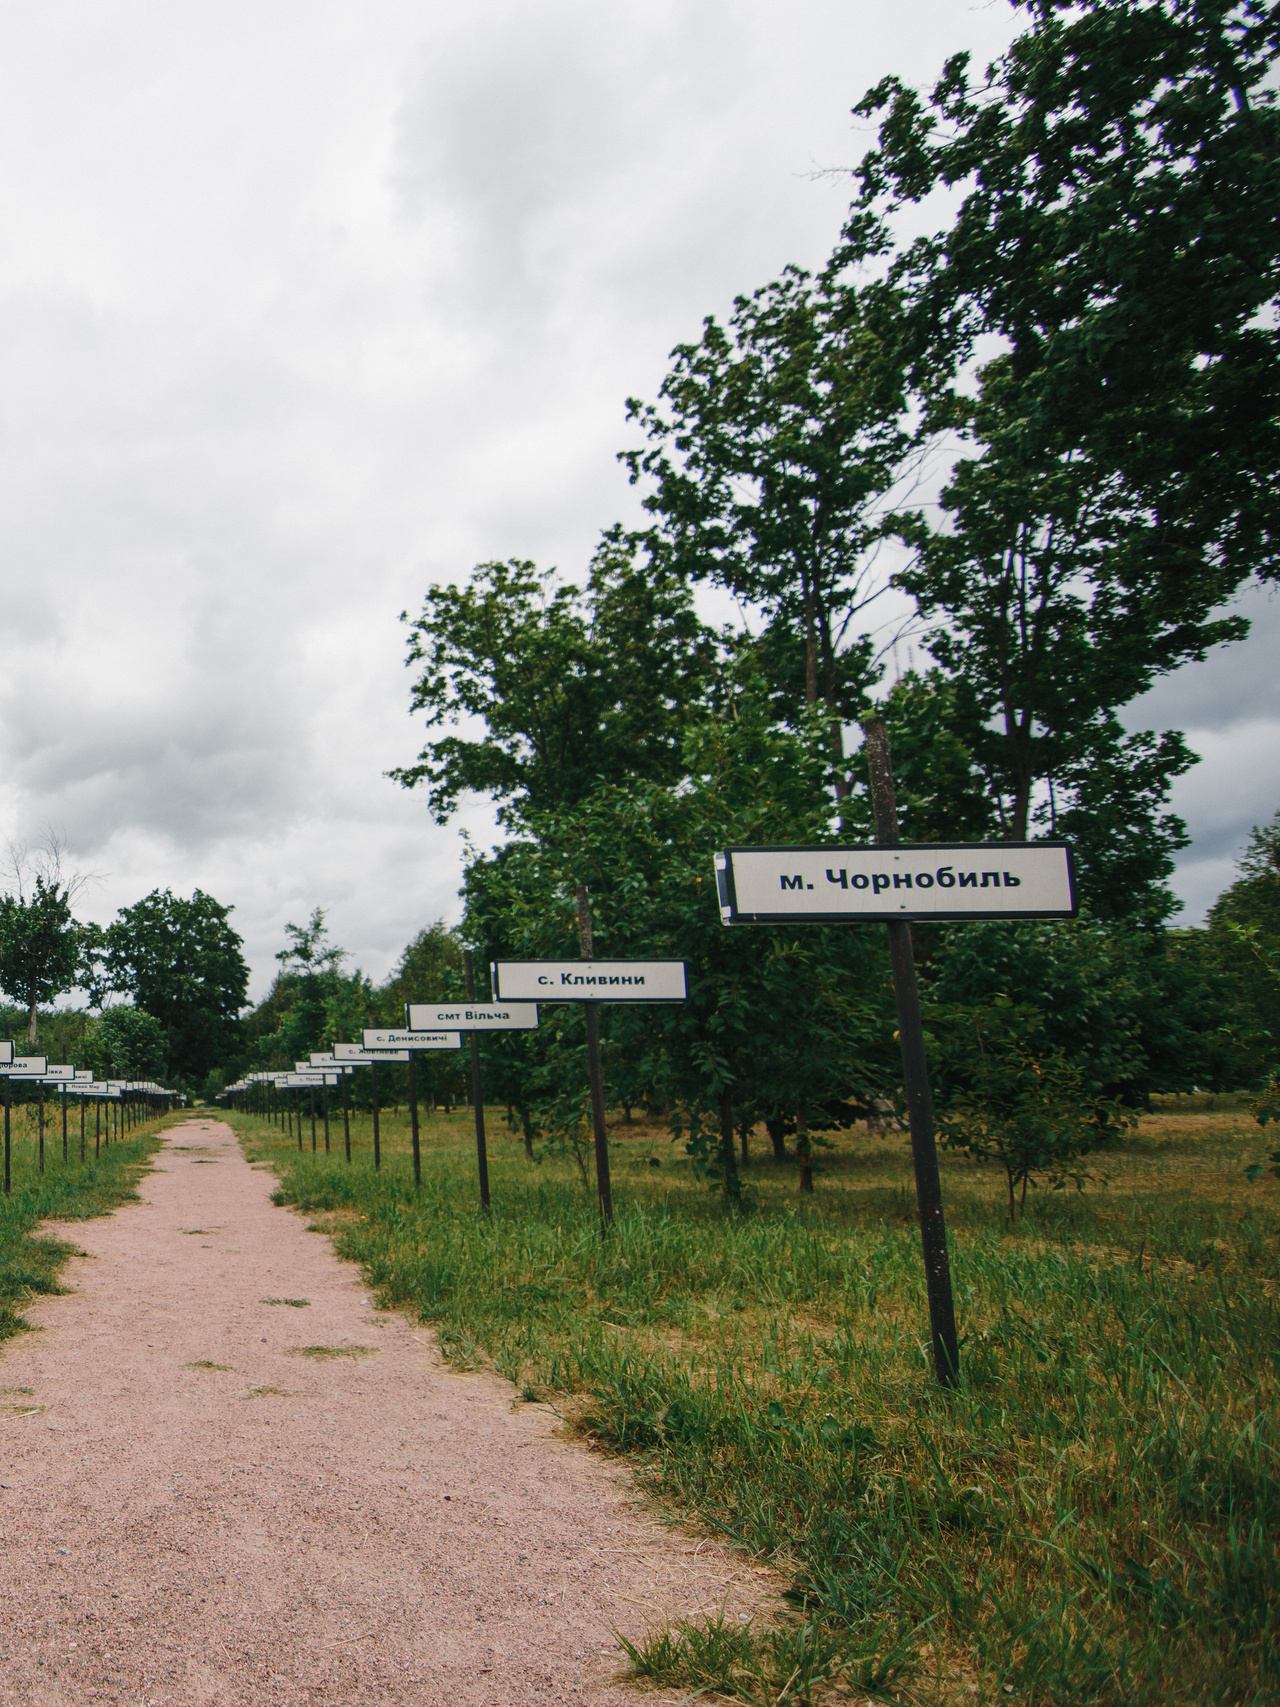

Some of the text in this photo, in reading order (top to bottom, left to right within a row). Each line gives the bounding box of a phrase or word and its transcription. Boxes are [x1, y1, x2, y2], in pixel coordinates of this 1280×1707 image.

[780, 866, 1022, 895] м. Чорнобиль
[537, 972, 646, 985] с. Кливини
[437, 1010, 510, 1021] смт Вільча
[388, 1034, 447, 1043] Денисовичі
